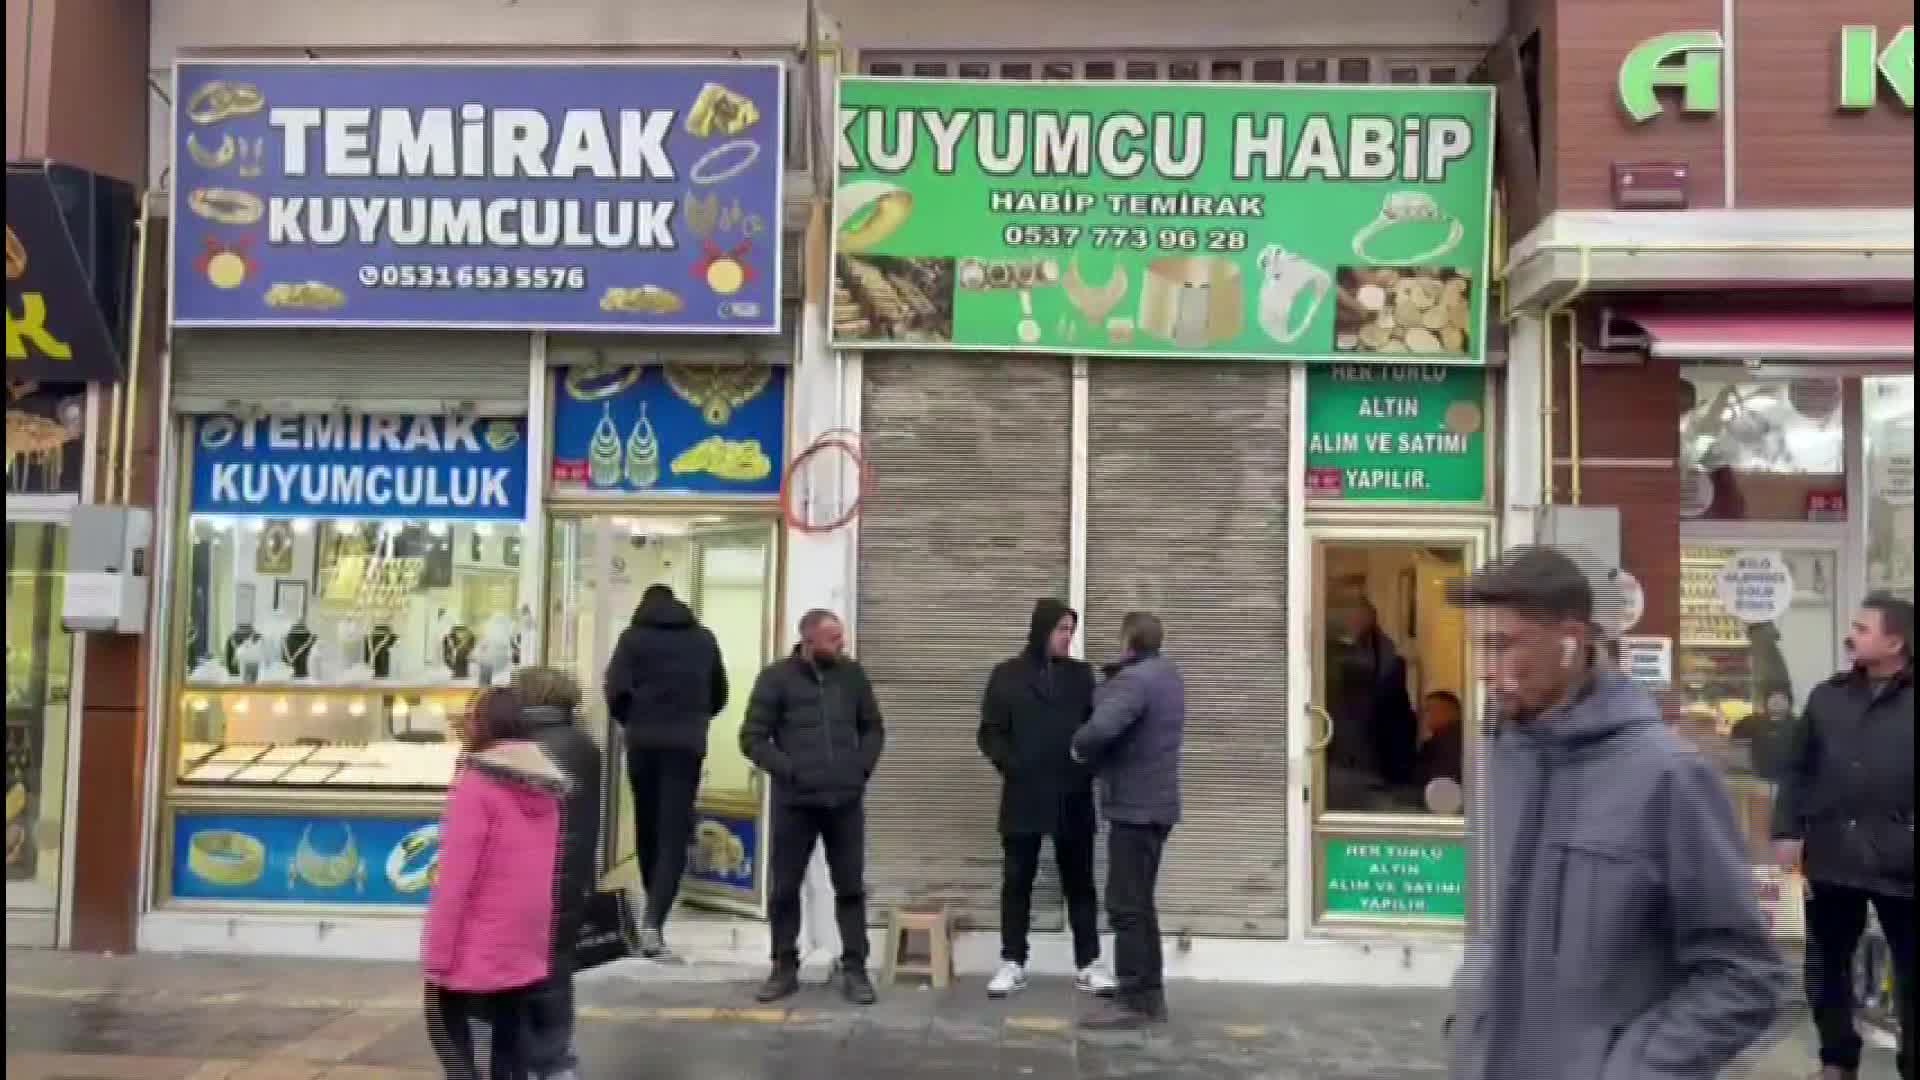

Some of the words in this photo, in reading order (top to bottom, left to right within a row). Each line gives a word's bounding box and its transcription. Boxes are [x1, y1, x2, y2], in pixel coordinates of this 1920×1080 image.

[268, 196, 678, 247] KUYUMCULUK
[1003, 224, 1081, 248] 0537
[1092, 226, 1149, 250] 773
[1157, 228, 1198, 251] 96
[1206, 229, 1248, 252] 28
[1358, 397, 1419, 418] ALTIN
[1310, 432, 1359, 455] ALIM
[1365, 432, 1393, 455] VE
[1398, 432, 1468, 455] SATIMI
[211, 463, 513, 506] KUYUMCULUK
